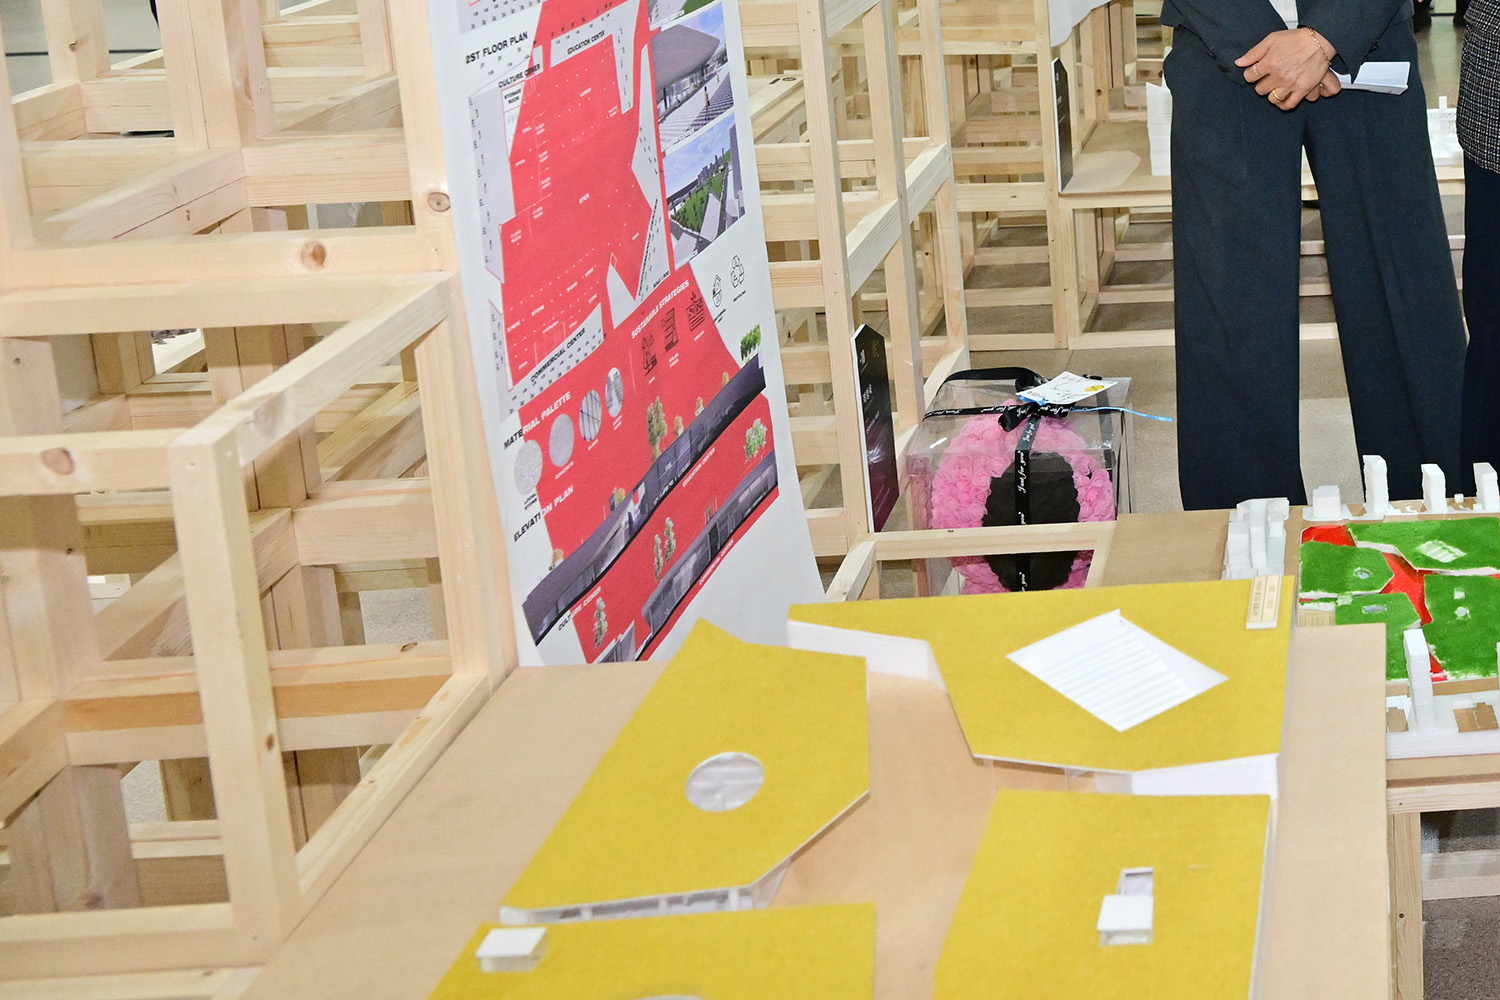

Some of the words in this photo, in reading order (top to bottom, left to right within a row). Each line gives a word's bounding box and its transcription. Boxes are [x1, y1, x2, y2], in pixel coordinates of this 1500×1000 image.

[465, 51, 480, 64] 2ST
[482, 40, 508, 58] FLOOR
[509, 31, 528, 46] PLAN
[567, 38, 591, 55] EDUCATION
[591, 30, 605, 43] CENTER
[498, 72, 523, 88] CULTURE
[631, 305, 660, 339] SUSTAINABLE
[657, 279, 690, 309] STRATEGIES
[530, 348, 566, 382] COMMERCIAL
[566, 327, 586, 349] CENTER
[503, 416, 541, 450] MATERIAL
[540, 391, 572, 420] PALETTE
[1017, 465, 1027, 480] for
[1019, 452, 1027, 467] you
[1017, 477, 1027, 494] Just
[513, 502, 553, 543] ELEVATION
[553, 485, 574, 508] PLAN
